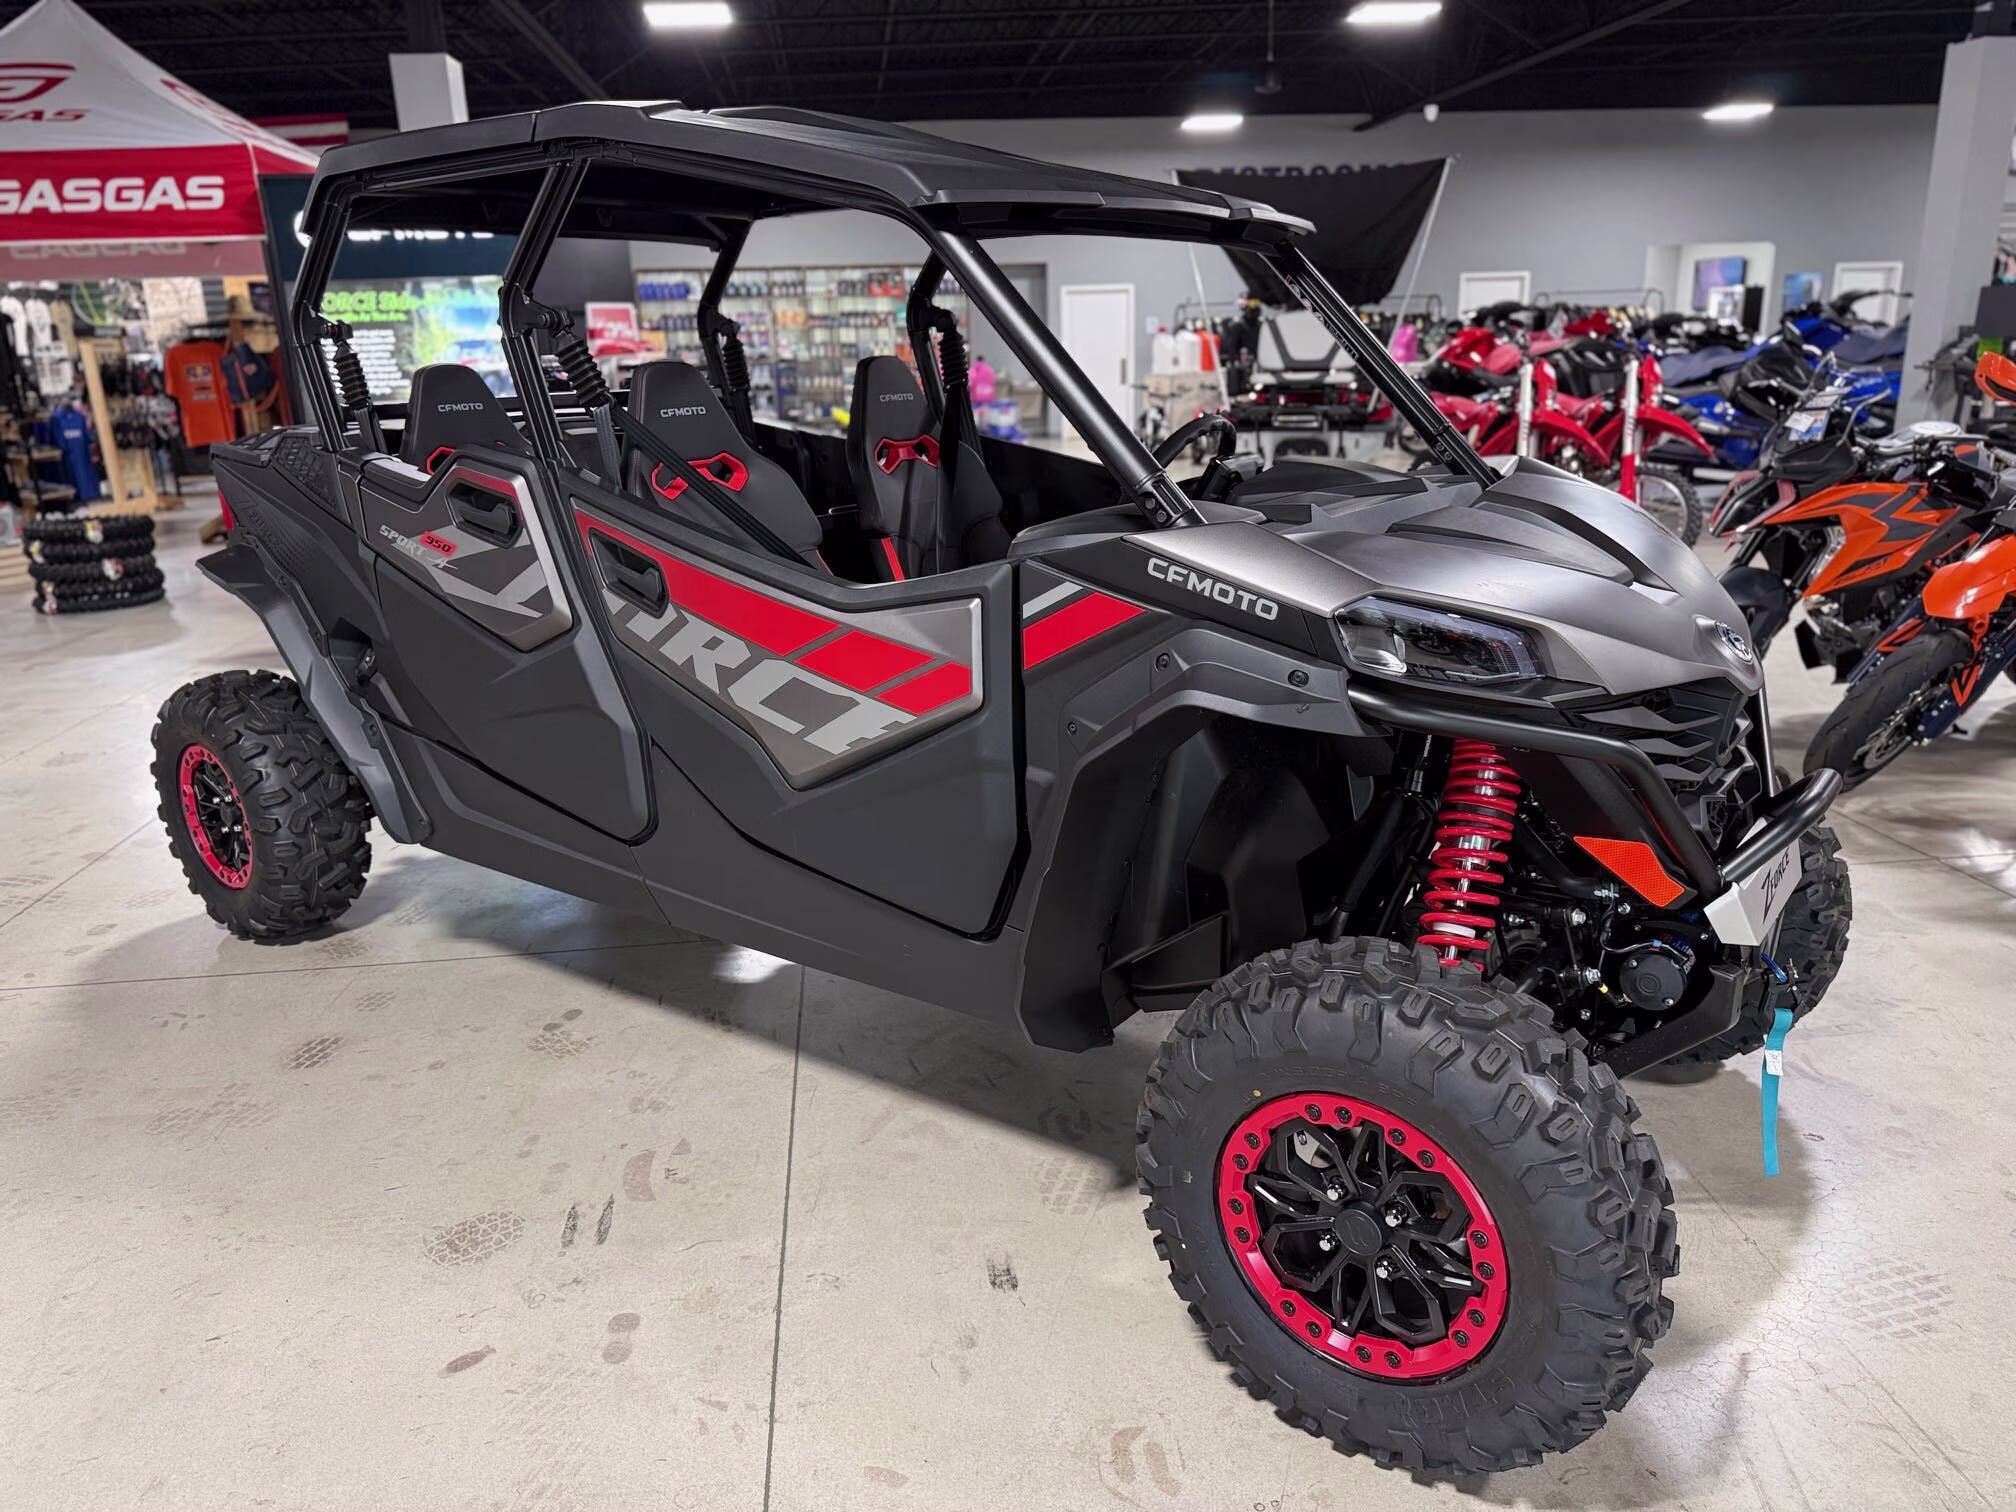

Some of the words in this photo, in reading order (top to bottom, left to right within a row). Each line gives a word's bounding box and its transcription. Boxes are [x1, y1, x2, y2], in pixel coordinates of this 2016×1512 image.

[880, 393, 914, 402] CFMOTO
[437, 402, 484, 412] CFMOTO
[660, 406, 706, 418] CFMOTO
[379, 525, 428, 556] SPORT
[424, 535, 453, 553] 950
[1147, 557, 1279, 621] CFMOTO
